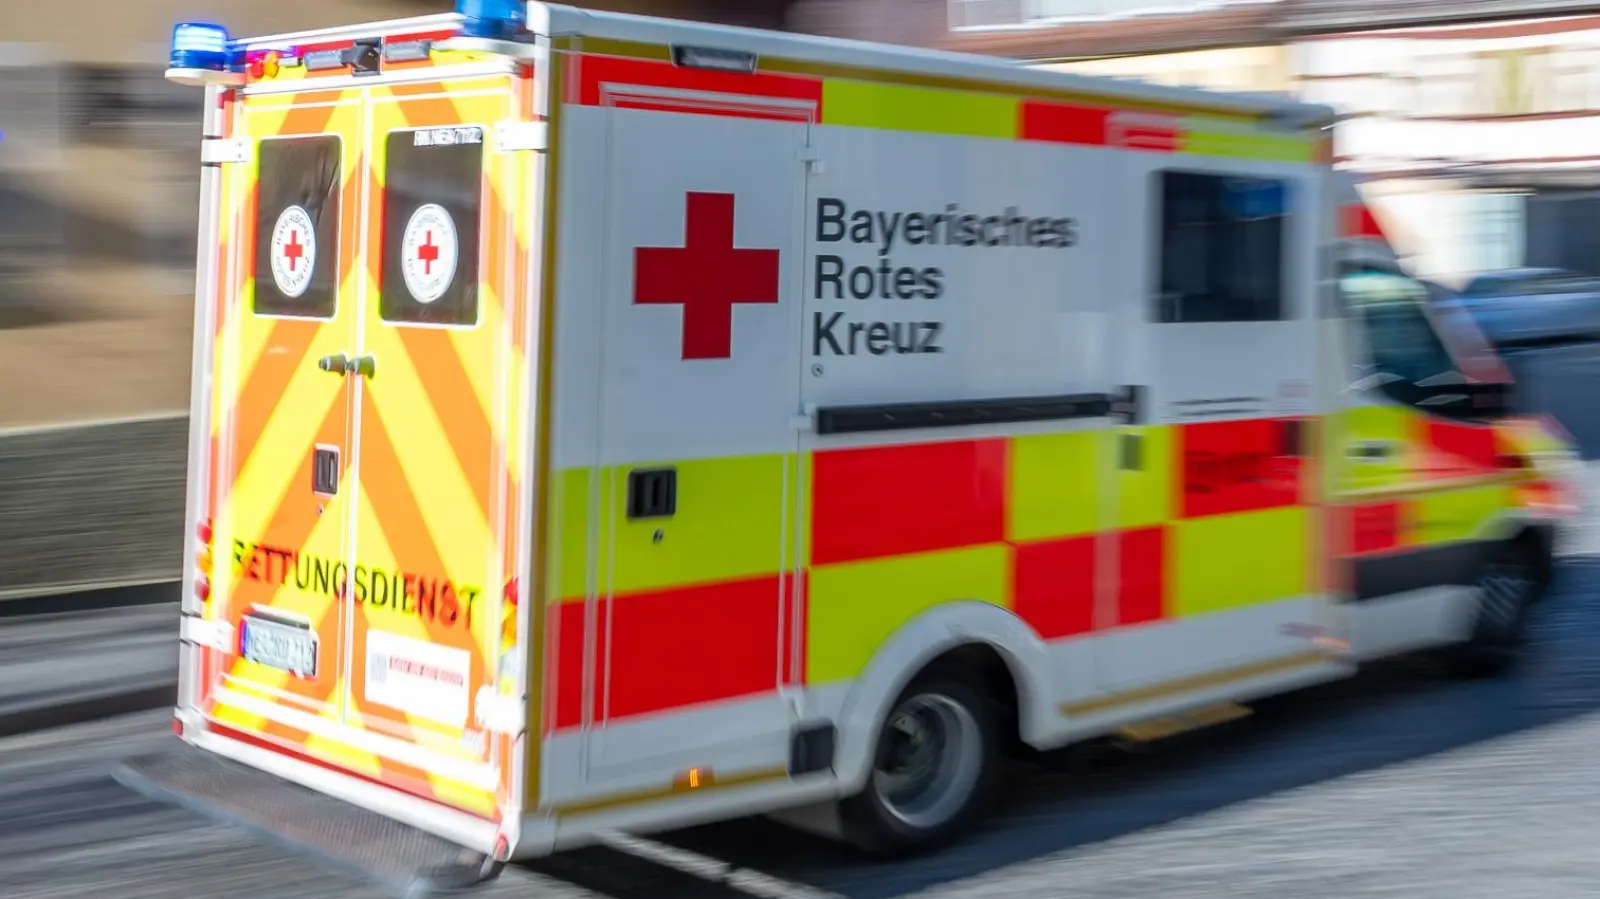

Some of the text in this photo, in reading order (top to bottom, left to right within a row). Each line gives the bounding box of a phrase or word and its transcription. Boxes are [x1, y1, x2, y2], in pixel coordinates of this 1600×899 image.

[815, 197, 1077, 255] Bayerisches
[813, 254, 943, 299] Rotes
[812, 311, 942, 356] Kreuz
[233, 538, 481, 629] RETTUNGSDIENST
